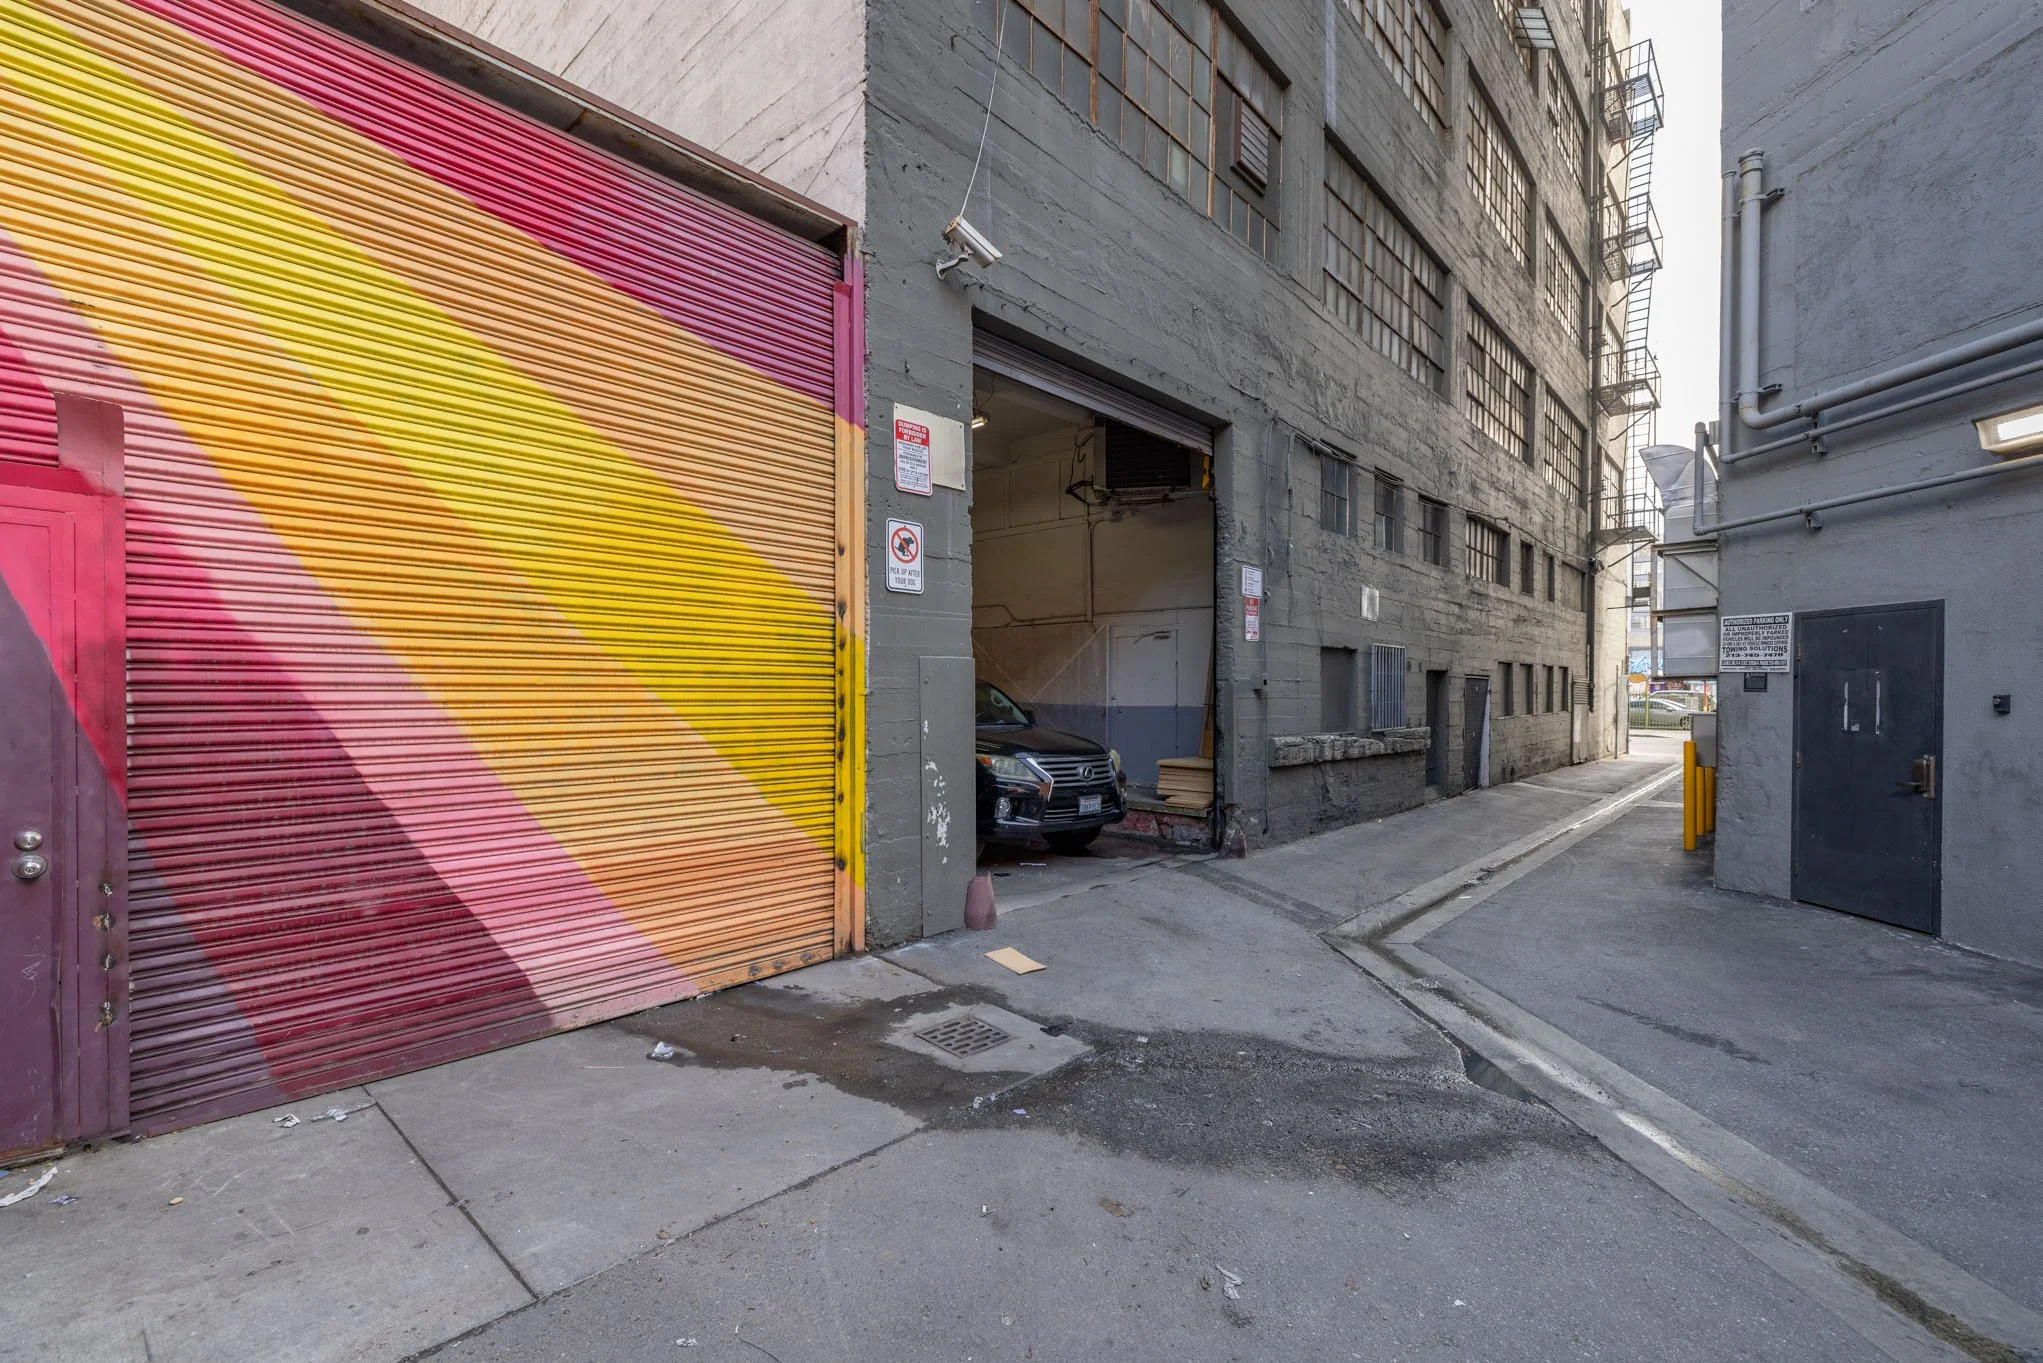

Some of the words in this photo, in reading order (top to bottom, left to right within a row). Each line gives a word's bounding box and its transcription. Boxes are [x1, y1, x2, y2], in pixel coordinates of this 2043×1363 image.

[898, 421, 921, 432] DUMPING
[898, 427, 926, 440] FORBIDDEN
[911, 436, 922, 444] LAW
[890, 566, 900, 574] PICK
[1722, 646, 1748, 654] TOWING
[1750, 646, 1788, 654] SOLUTIONS
